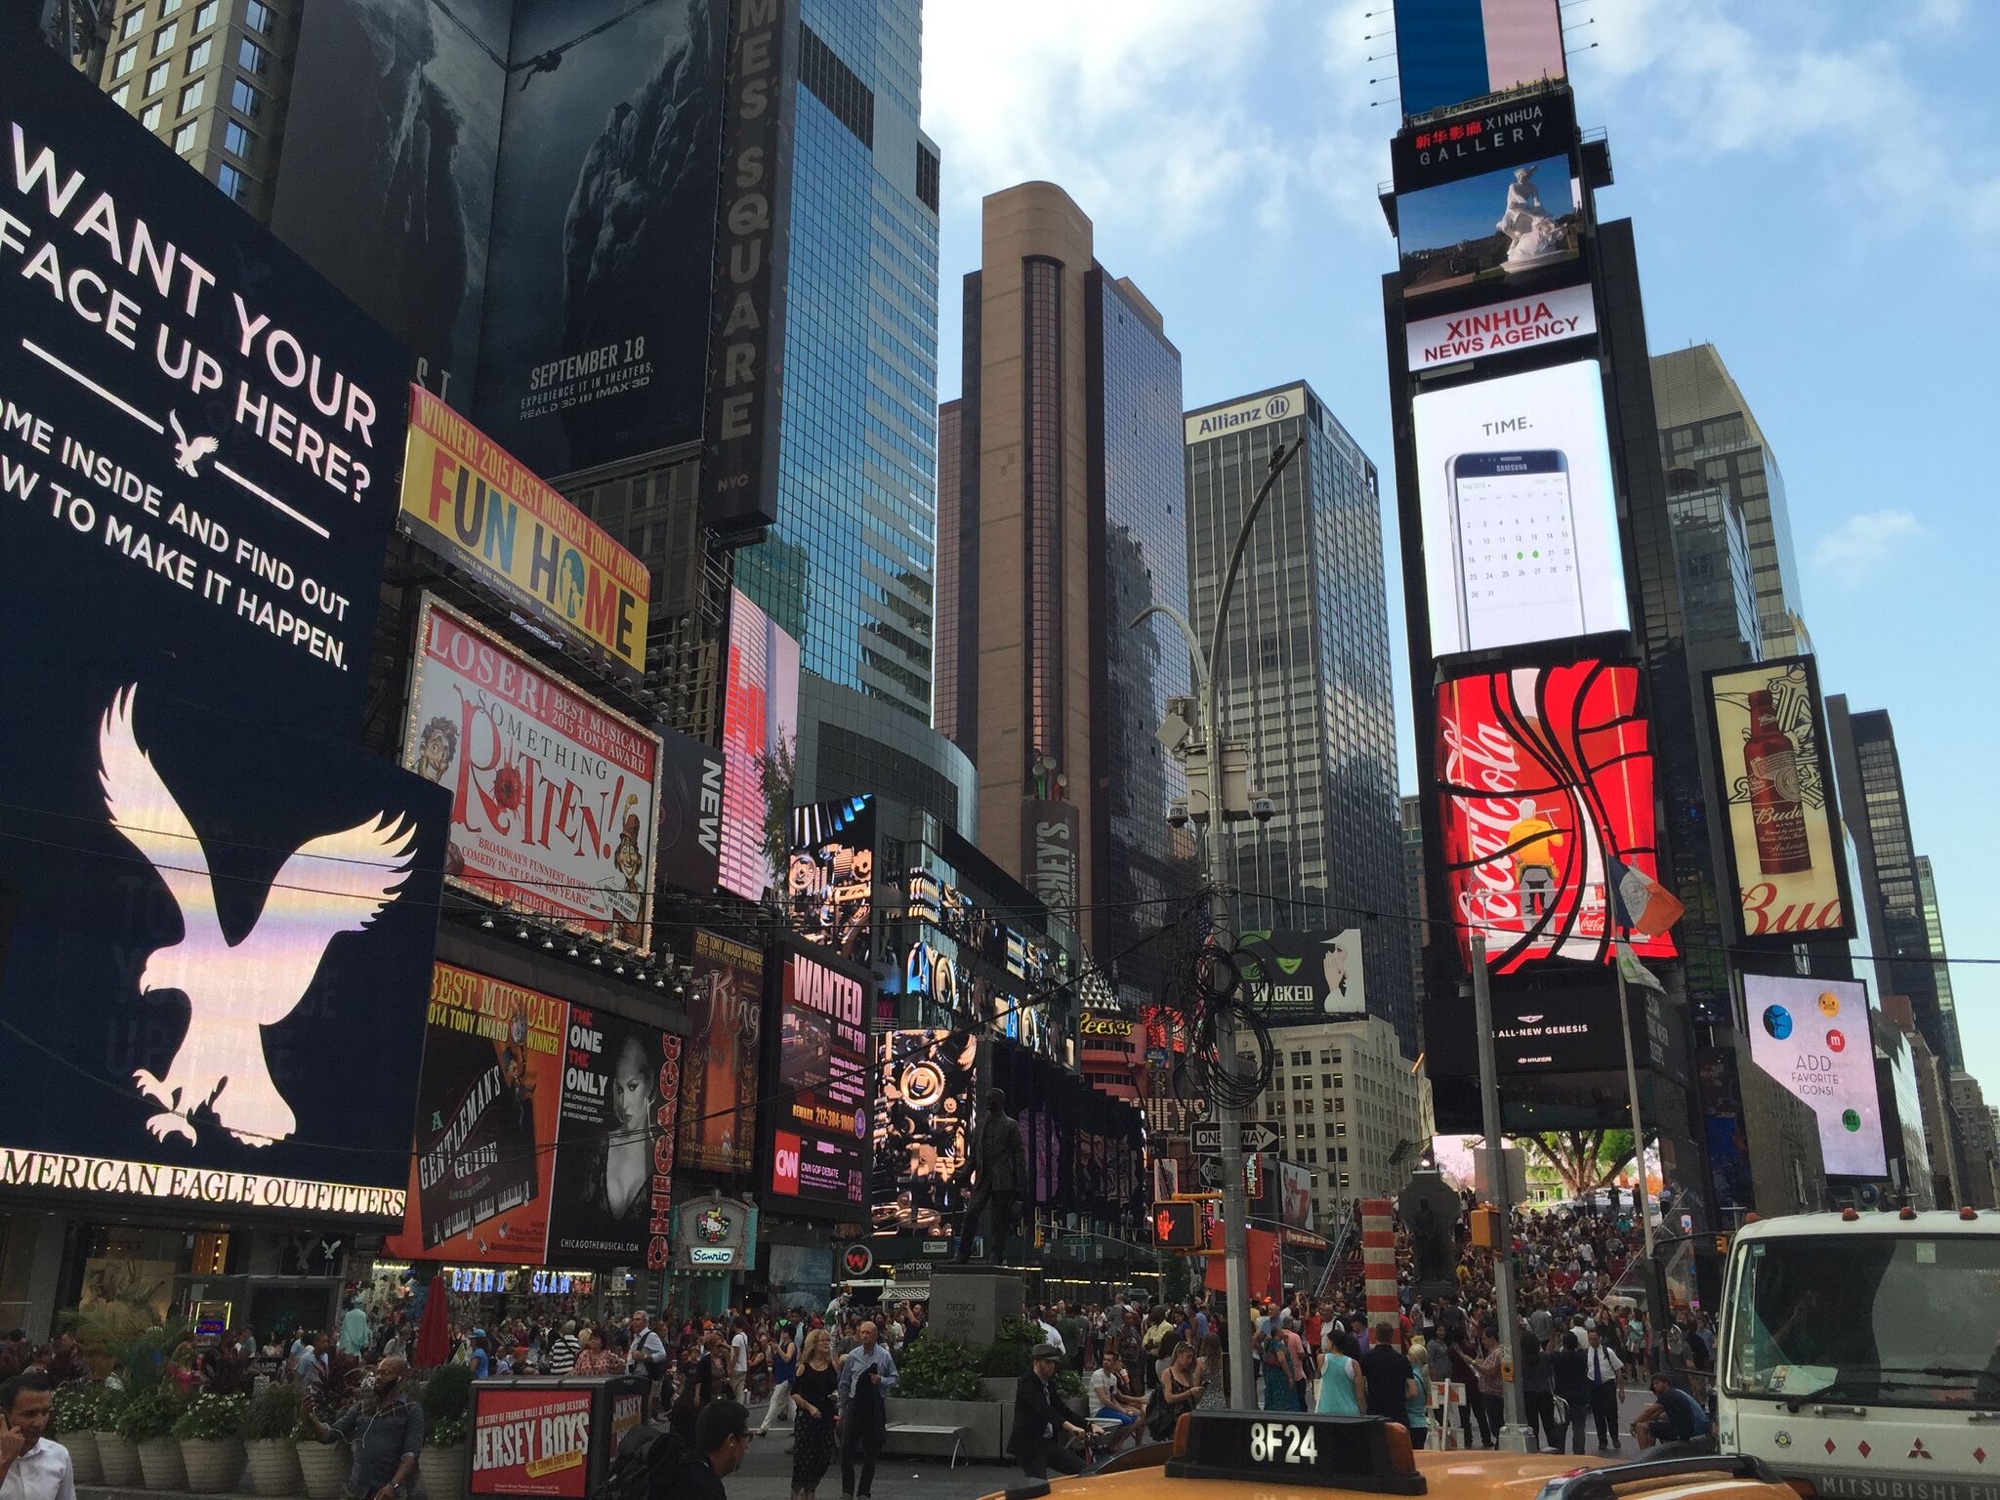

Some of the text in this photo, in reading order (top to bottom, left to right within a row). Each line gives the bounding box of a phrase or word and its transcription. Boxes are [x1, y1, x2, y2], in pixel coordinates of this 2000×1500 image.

[1486, 105, 1543, 131] XINHUA
[1419, 122, 1544, 166] GALLERY
[12, 121, 377, 448] WANT YOUR
[720, 147, 770, 441] SQUARE
[1424, 316, 1579, 362] NEWS AGENCY
[1446, 302, 1553, 341] XINHUA
[0, 208, 371, 503] FACE UP HERE?
[530, 336, 645, 391] SEPTEMBER 18
[521, 384, 575, 409] EXPERIENCE
[578, 380, 587, 393] IT
[591, 377, 600, 389] IN
[561, 397, 577, 411] 3D
[596, 383, 630, 399] IMAX
[631, 376, 650, 390] 3D
[1199, 407, 1261, 435] Allianz
[1482, 416, 1533, 437] TIME.
[718, 473, 749, 493] NYC
[1496, 464, 1527, 472] SAMSUNG
[0, 399, 350, 622] ME INSIDE AND FIND OUT
[421, 393, 649, 596] WINNER! 2015 BEST MUSICAL TONY AWARD
[428, 447, 518, 574] FUN
[50, 482, 95, 532] TO
[105, 515, 197, 589] MAKE
[204, 569, 231, 605] IT
[237, 588, 348, 671] HAPPEN.
[428, 614, 549, 718] LOSER!
[477, 689, 607, 780] SOMETHING
[551, 710, 646, 773] 2015 TONY AWARD
[554, 692, 646, 760] BEST MUSICAL!
[697, 758, 724, 858] NEW
[462, 846, 497, 867] COMEDY
[499, 862, 507, 872] IN
[508, 864, 519, 878] AT
[520, 868, 543, 888] LEAST
[545, 879, 558, 895] 400
[529, 856, 565, 884] FUNNIEST
[567, 874, 597, 896] MUSICAL
[479, 978, 564, 1034] MUSICAL!
[793, 953, 863, 1027] WANTED
[450, 1009, 476, 1033] TONY
[476, 1017, 508, 1043] AWARD
[526, 1031, 559, 1055] WINNER
[572, 1007, 593, 1027] THE
[1498, 1027, 1542, 1038] ALL-NEW
[1545, 1024, 1588, 1035] GENESIS
[568, 1049, 589, 1068] THE
[570, 1025, 603, 1054] ONE
[854, 1030, 866, 1054] FBI
[566, 1067, 608, 1097] ONLY
[1792, 1072, 1839, 1084] FAVORITE
[1796, 1055, 1831, 1072] ADD
[1799, 1084, 1835, 1096] ICONS!
[420, 1064, 502, 1190] GENTLEMAN'S
[431, 1111, 443, 1132] A
[1199, 1131, 1267, 1144] ONE WAY
[454, 1141, 498, 1180] GUIDE
[647, 1033, 682, 1271] CHICAGO
[776, 1149, 799, 1179] CNN
[801, 1162, 812, 1172] CNN
[822, 1166, 839, 1178] DEBATE
[1205, 1166, 1218, 1178] ONE
[170, 1168, 257, 1203] EAGLE
[264, 1179, 404, 1217] OUTFITTERS
[560, 1238, 640, 1252] CHICAGOTHEMUSICAL.COM
[452, 1270, 571, 1294] GRAND SLAM
[903, 1262, 932, 1271] HOT DOGS
[544, 1405, 553, 1415] THE
[553, 1402, 566, 1414] FOUR
[567, 1399, 589, 1411] SEASONS
[473, 1420, 536, 1471] JERSEY
[541, 1411, 590, 1459] BOYS
[1250, 1423, 1318, 1465] 8F24
[1822, 1477, 1956, 1500] MITSUBISHI
